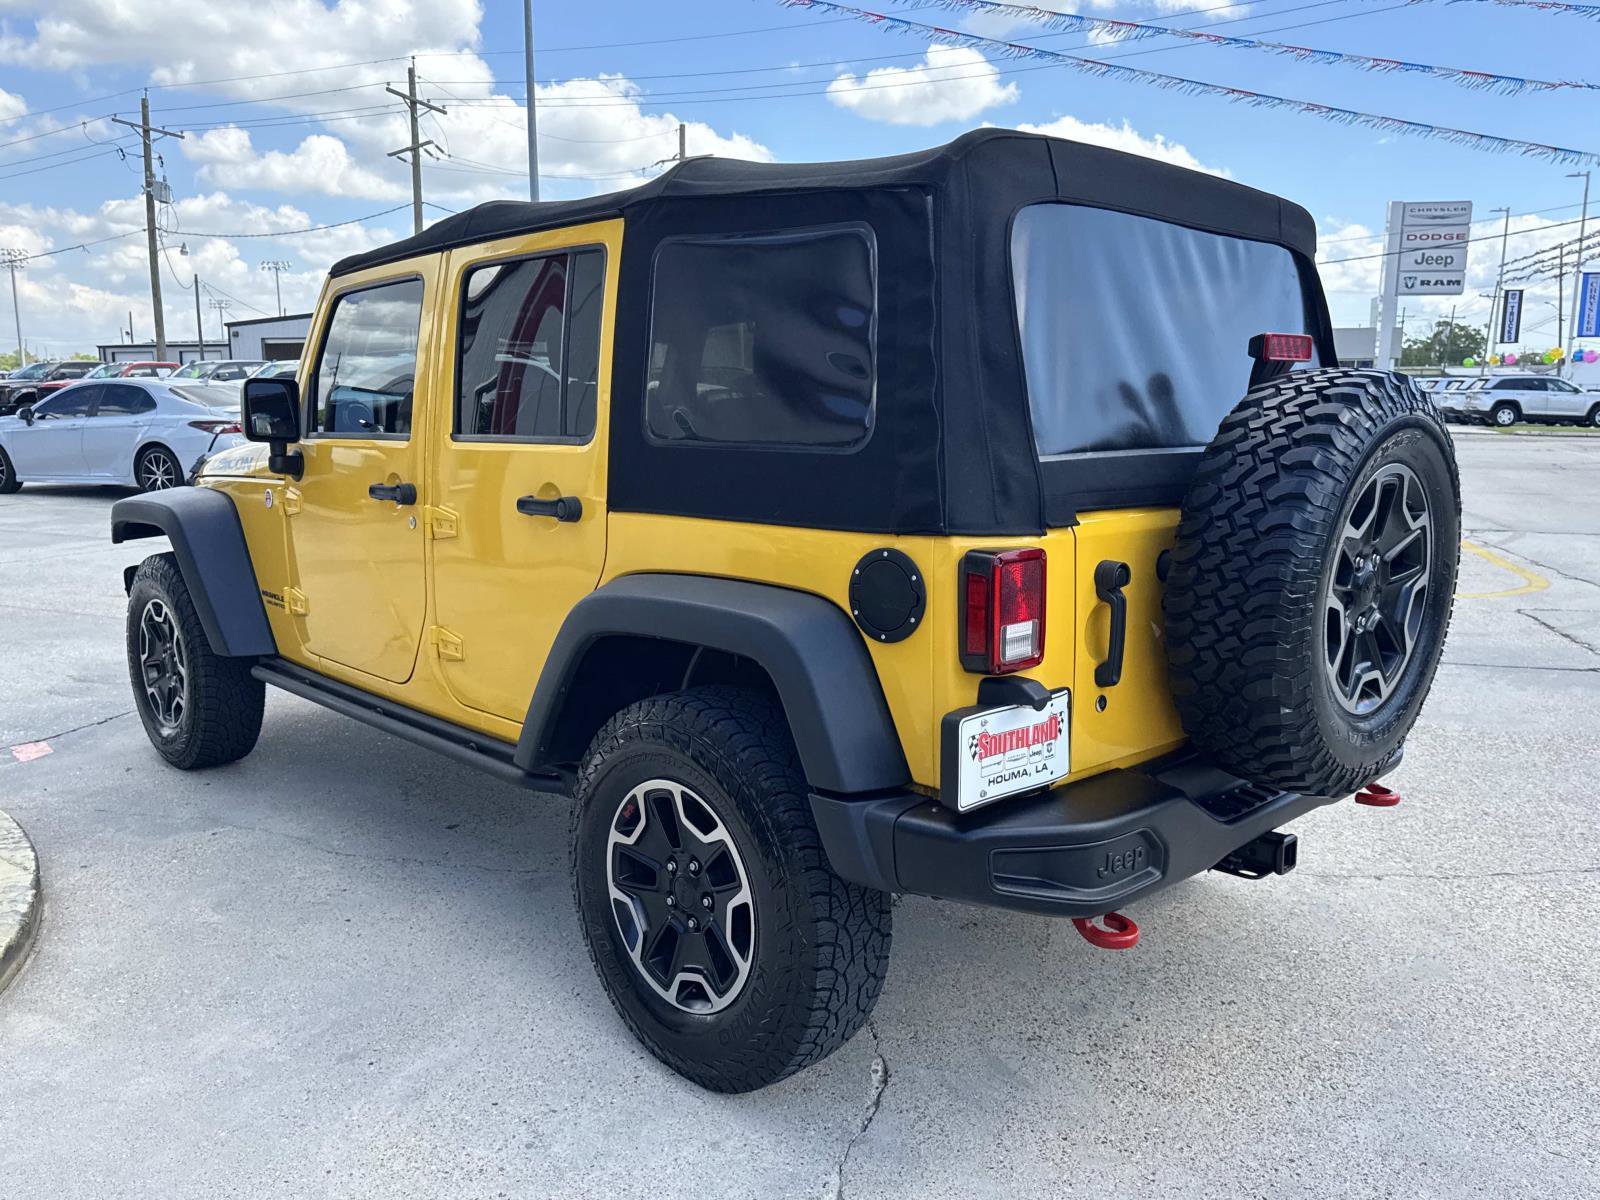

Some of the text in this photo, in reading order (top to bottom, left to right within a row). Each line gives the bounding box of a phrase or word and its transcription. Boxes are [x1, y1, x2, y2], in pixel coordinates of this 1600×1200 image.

[1407, 233, 1466, 241] DODGE
[1414, 252, 1455, 268] Jeep
[1420, 279, 1462, 287] RAM
[1507, 305, 1515, 341] TRUCKS
[977, 713, 1059, 761] SOUTHLAND
[988, 763, 1048, 787] HOUMA, LA
[1096, 846, 1143, 879] Jeep
